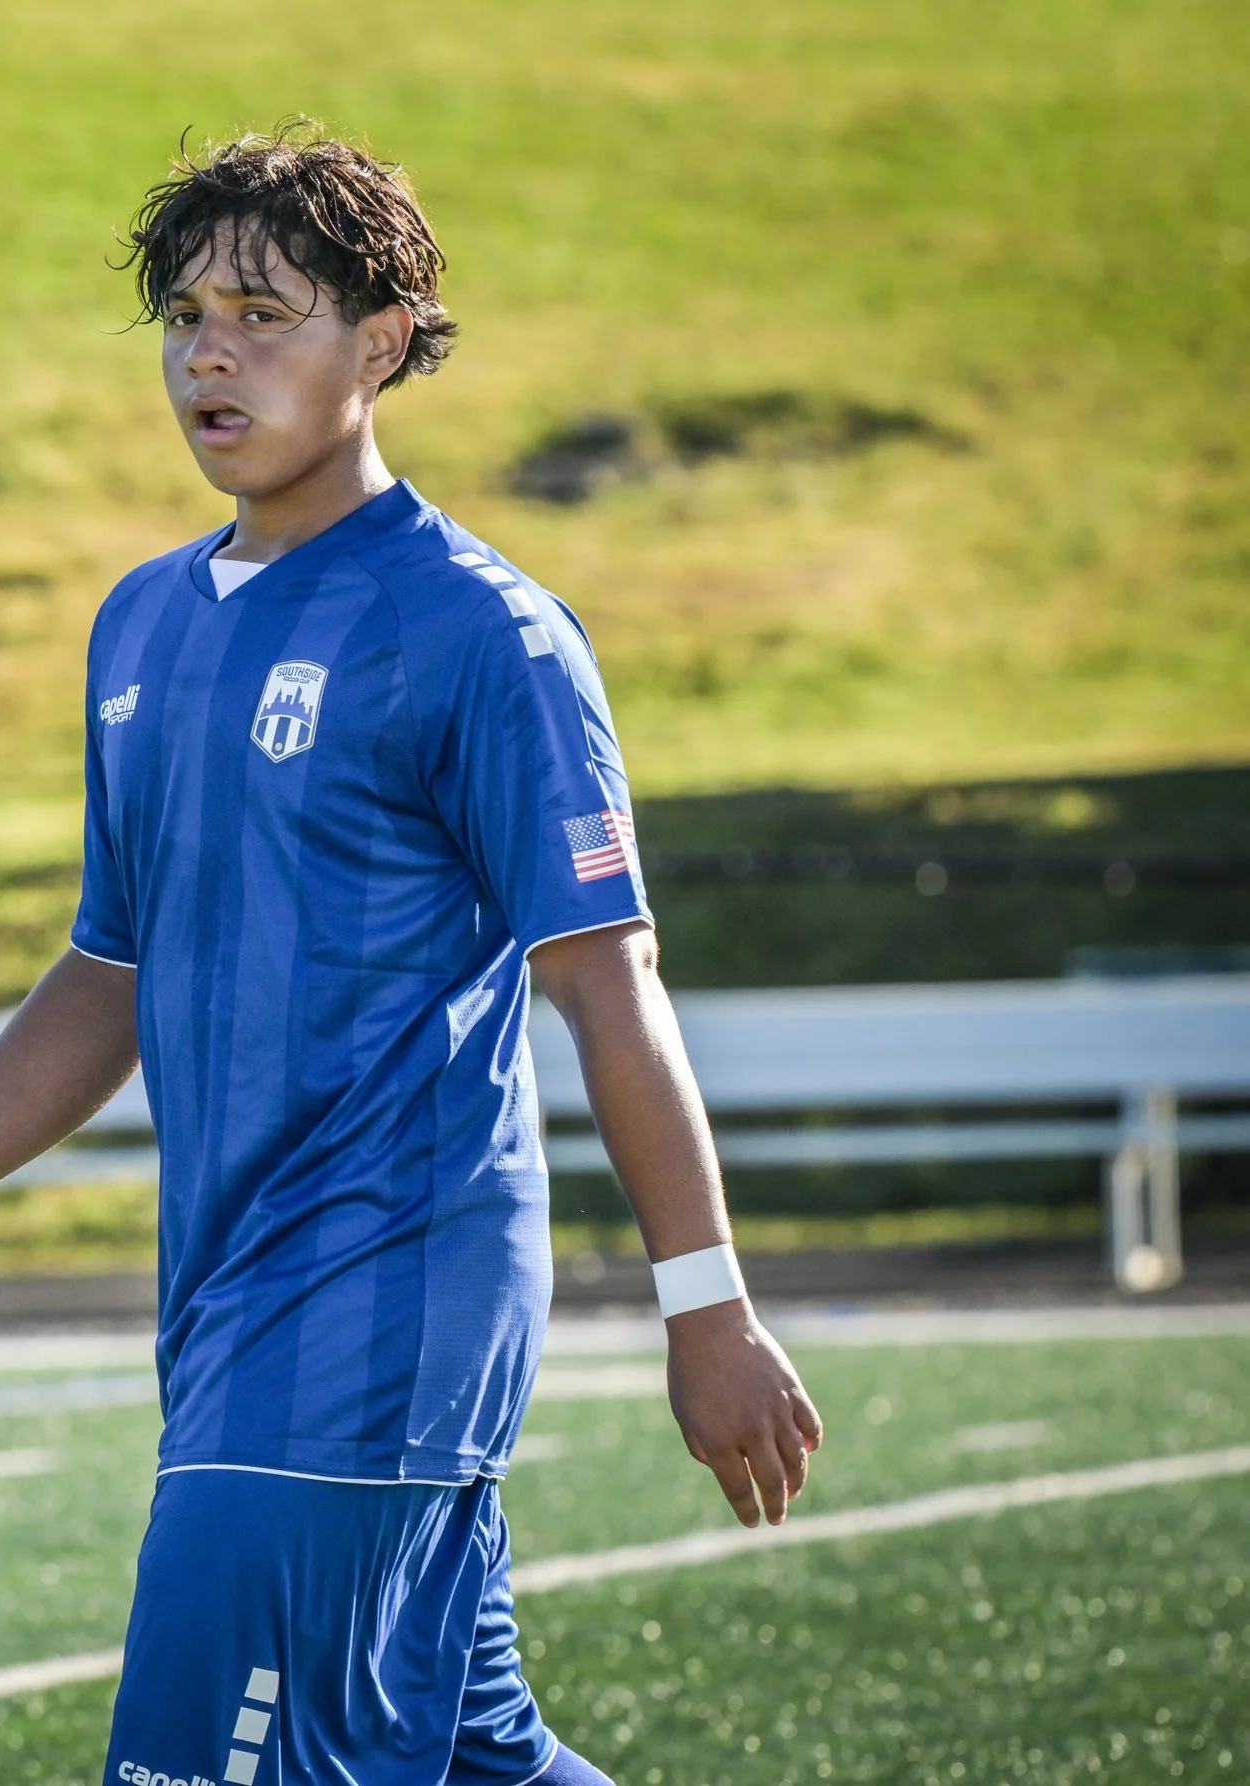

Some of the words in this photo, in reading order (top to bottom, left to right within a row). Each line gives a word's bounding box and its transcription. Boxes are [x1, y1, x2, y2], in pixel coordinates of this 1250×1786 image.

[276, 666, 323, 682] SOUTHSIDE
[100, 684, 141, 725] capelli
[110, 711, 134, 726] SPORT
